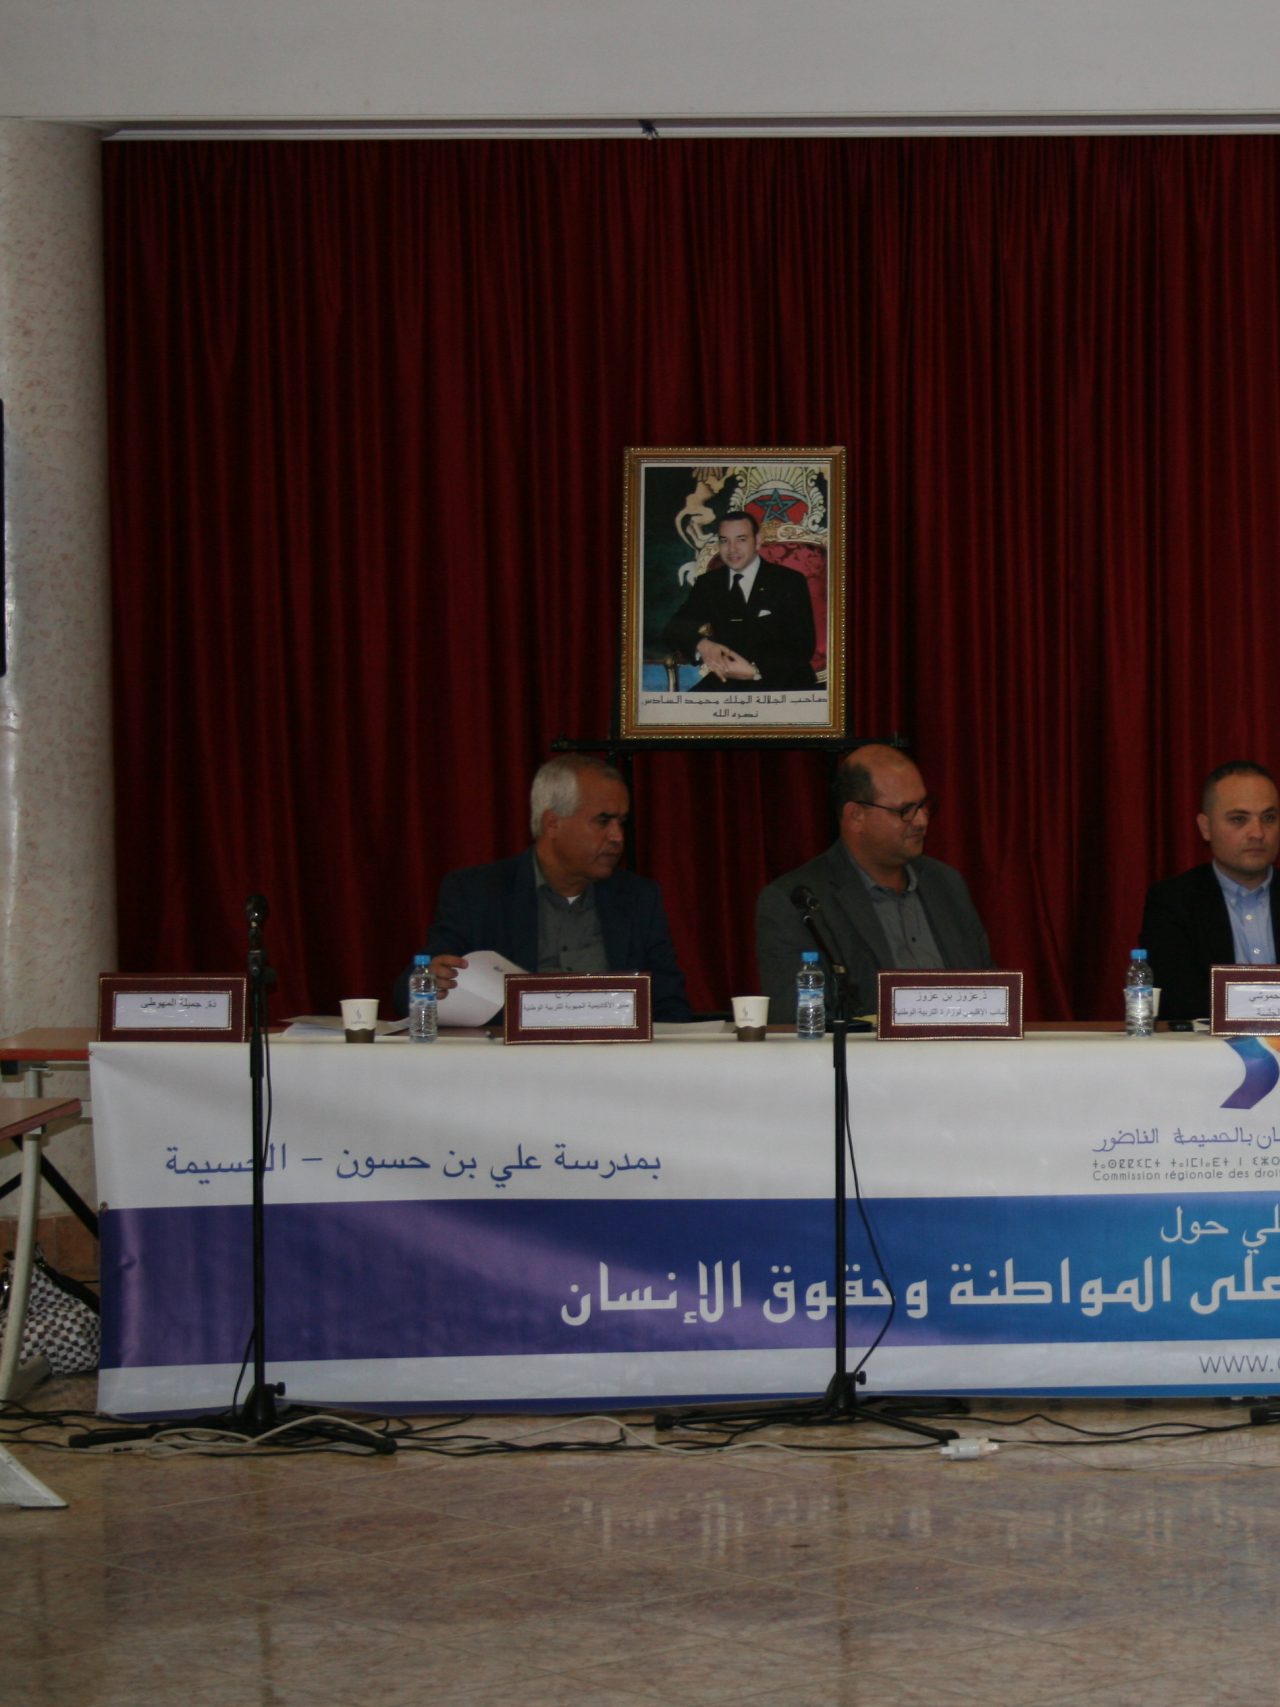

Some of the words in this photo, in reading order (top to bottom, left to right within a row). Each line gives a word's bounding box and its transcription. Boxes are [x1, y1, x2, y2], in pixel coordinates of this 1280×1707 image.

[1092, 1127, 1160, 1152] الناضور
[1173, 1126, 1254, 1148] بالحسيمة
[336, 1146, 430, 1179] حسون
[442, 1148, 478, 1180] بن
[490, 1144, 542, 1189] علي
[554, 1143, 661, 1181] بمدرسة
[1092, 1170, 1161, 1182] Commission
[1165, 1168, 1224, 1182] régionale
[1228, 1168, 1250, 1179] des
[1160, 1206, 1229, 1244] حول
[560, 1260, 741, 1326] الإنسان
[763, 1264, 928, 1324] وحقوق
[950, 1255, 1171, 1318] المواطنة
